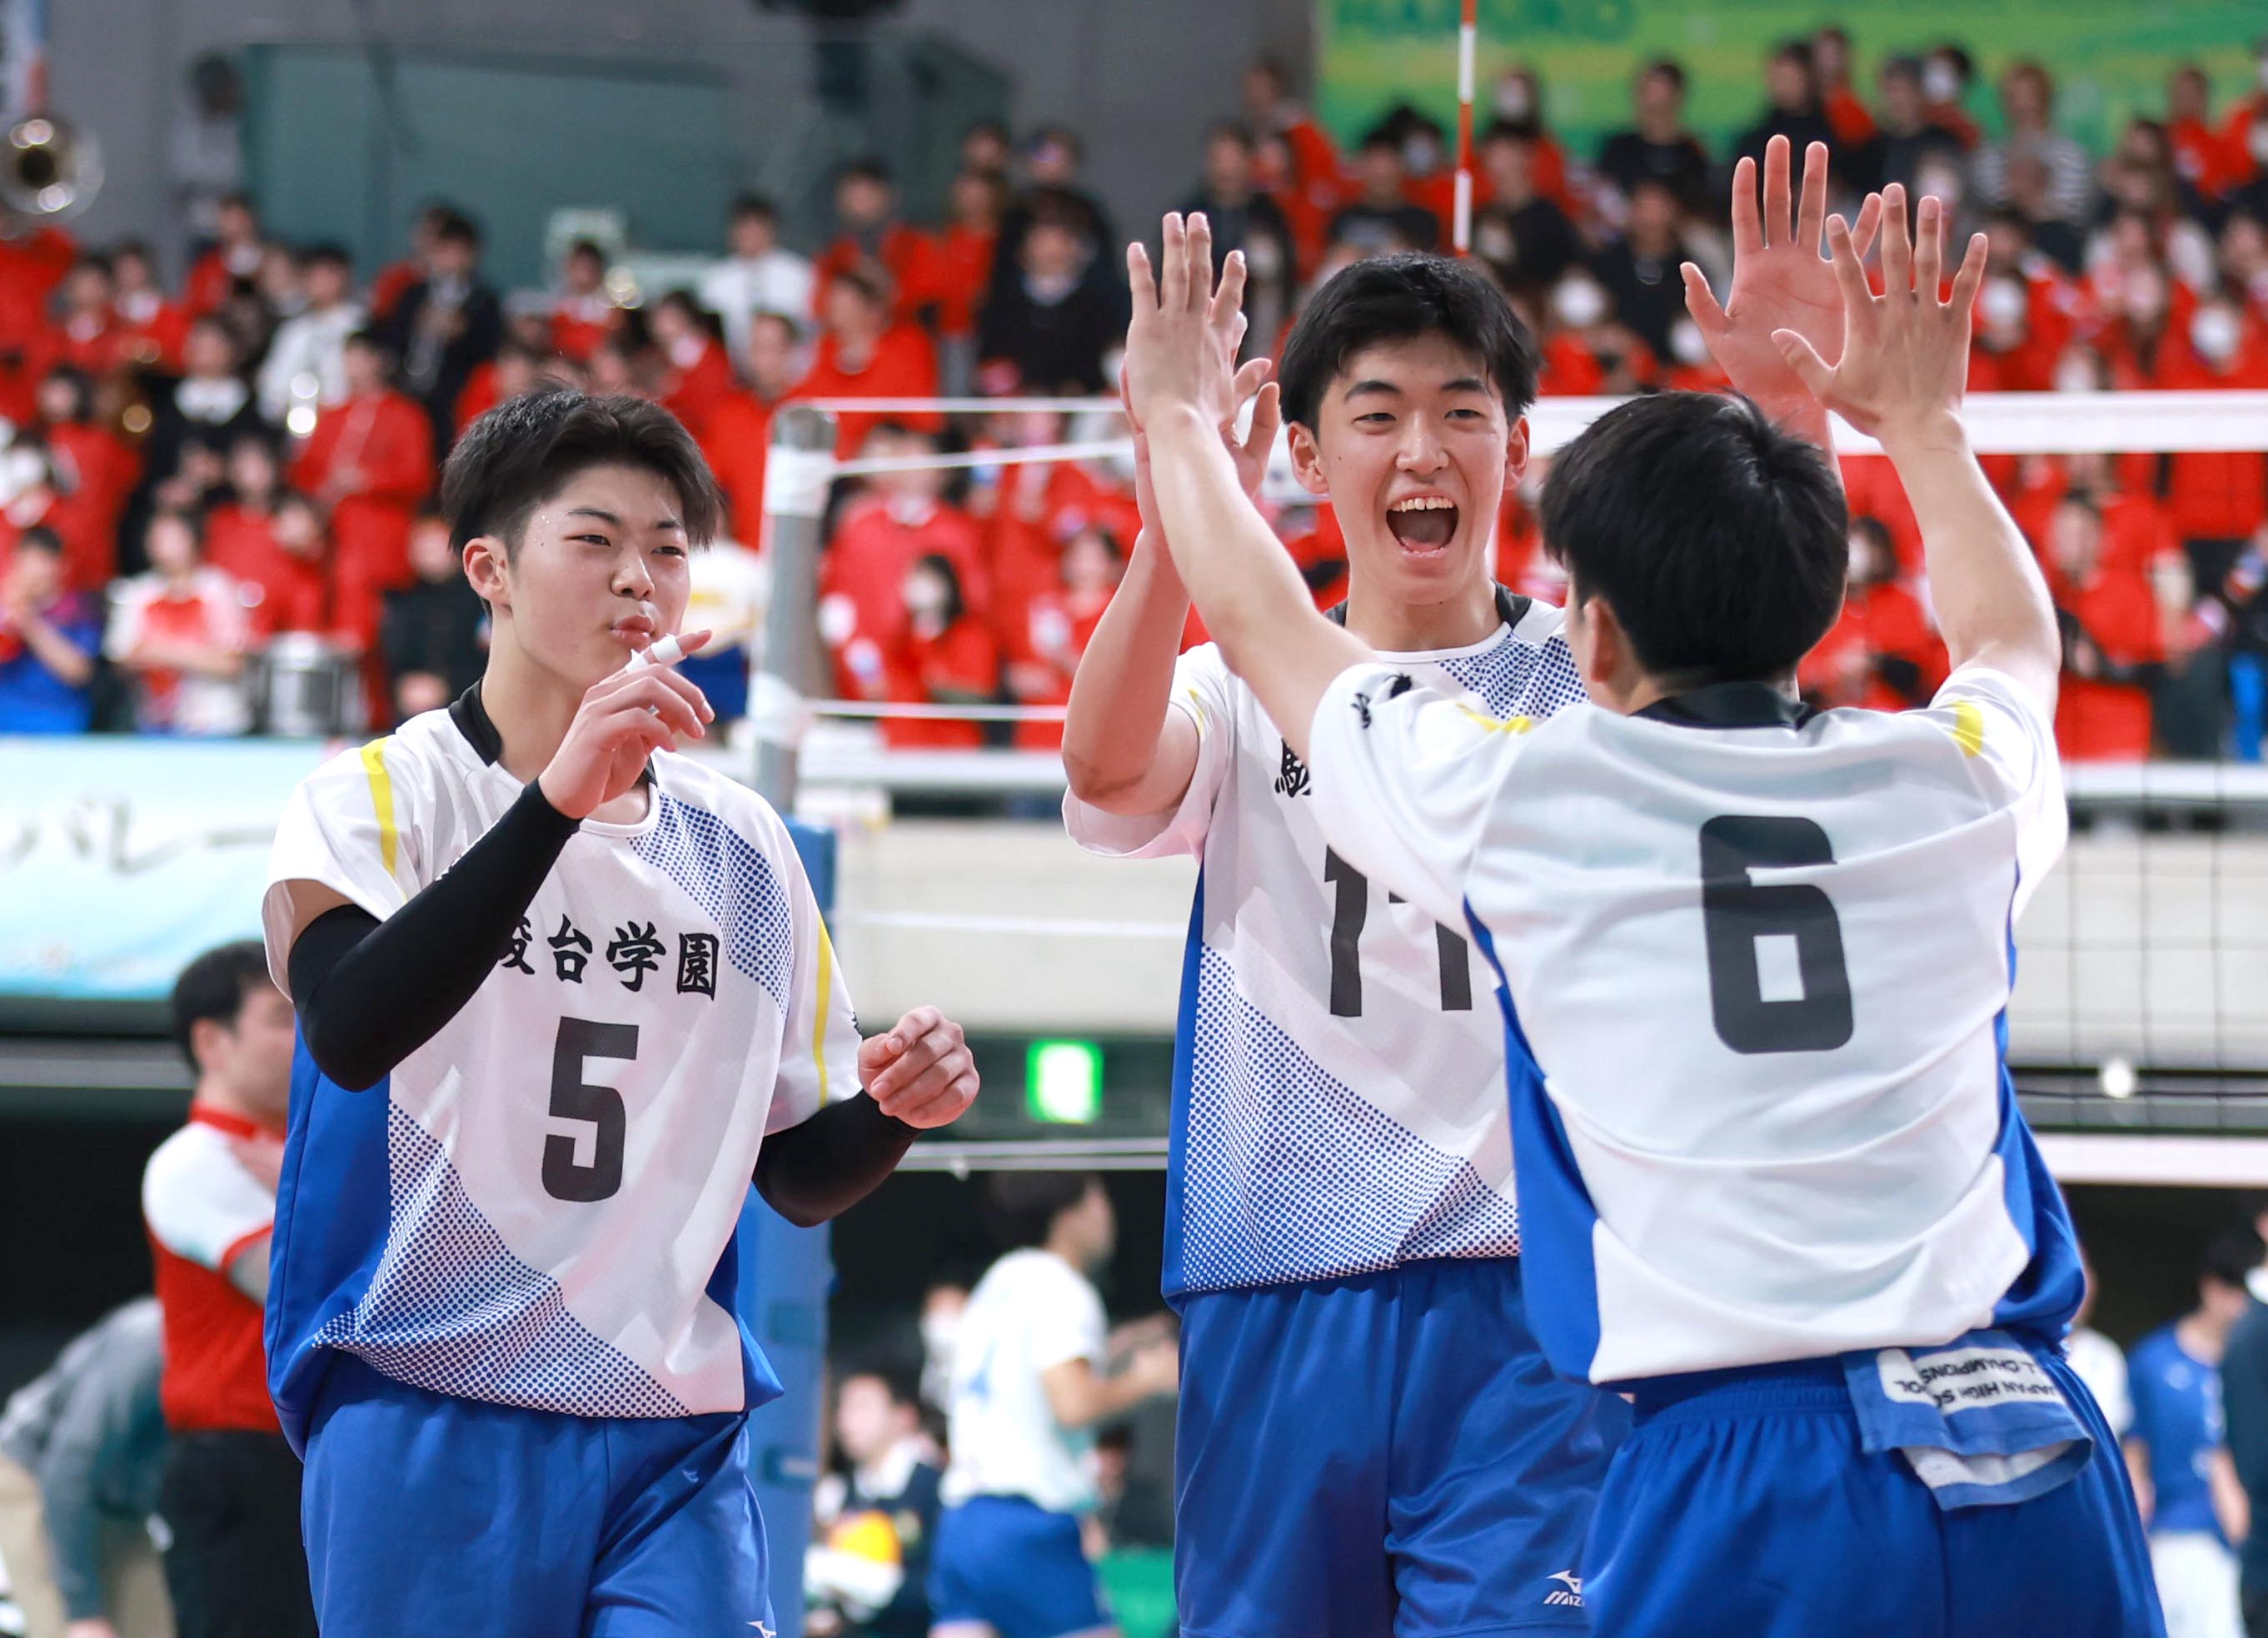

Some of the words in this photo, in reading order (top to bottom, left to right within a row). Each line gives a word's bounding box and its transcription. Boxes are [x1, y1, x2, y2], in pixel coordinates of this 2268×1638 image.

[1699, 814, 1854, 1054] 6
[541, 1015, 640, 1202] 5
[1957, 1382, 2001, 1400] HIGH
[1543, 1590, 1584, 1607] MIZ
